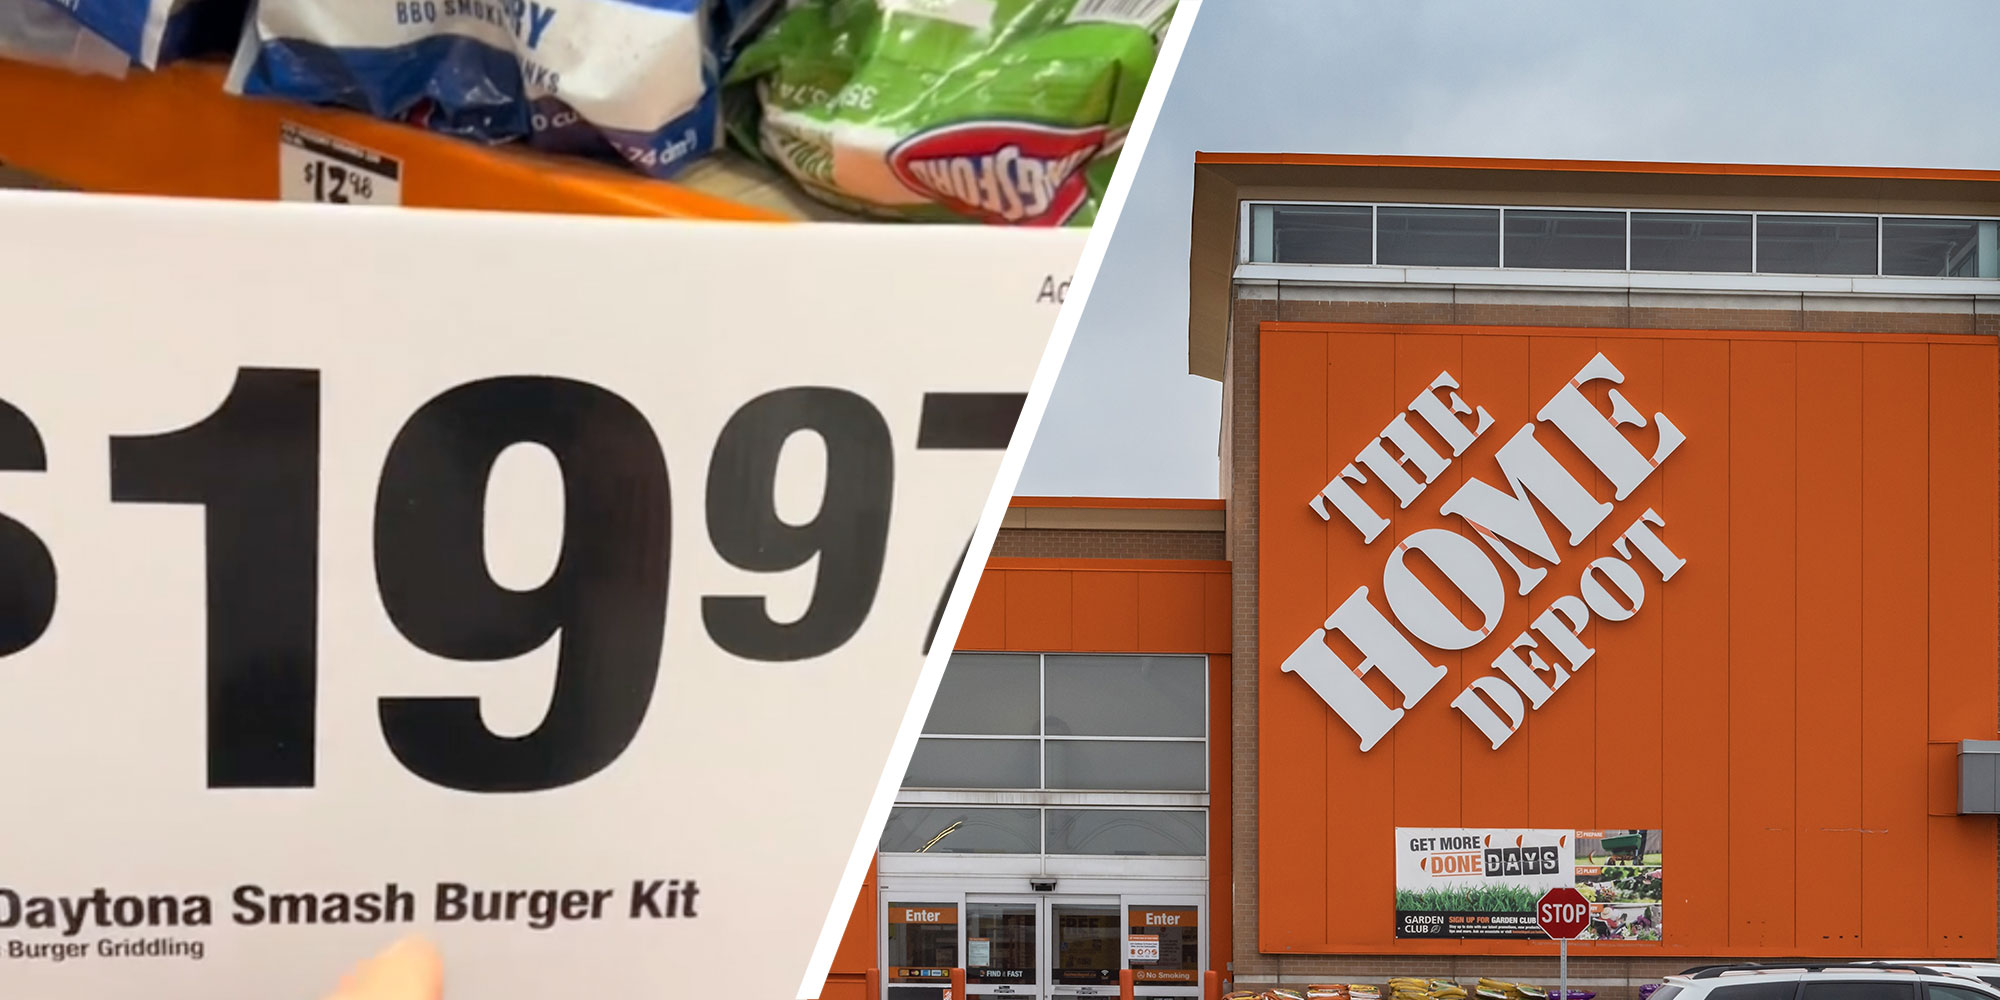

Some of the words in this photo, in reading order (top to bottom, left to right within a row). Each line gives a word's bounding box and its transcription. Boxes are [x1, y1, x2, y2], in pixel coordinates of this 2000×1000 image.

[397, 1, 436, 24] BBQ
[1308, 370, 1496, 545] THE
[1280, 352, 1687, 752] HOME
[1450, 507, 1687, 750] DEPOT
[1410, 838, 1436, 851] GET
[1440, 836, 1481, 850] MORE
[1431, 855, 1482, 874] DONE
[1487, 851, 1556, 873] DAYS
[0, 887, 212, 937] Daytona
[231, 884, 415, 924] Smash
[434, 882, 613, 930] Burger
[629, 879, 699, 919] Kit
[906, 909, 941, 922] Enter
[1541, 903, 1587, 924] STOP
[1145, 913, 1180, 925] Enter
[1404, 915, 1444, 924] GARDEN
[1404, 924, 1429, 933] CLUB
[1449, 916, 1465, 924] SIGN
[1466, 916, 1475, 924] UP
[1477, 916, 1490, 924] FOR
[1491, 916, 1518, 924] GARDEN
[8, 939, 90, 962] Burger
[97, 936, 204, 960] Griddling
[1146, 971, 1157, 979] No
[1158, 972, 1190, 980] Smoking
